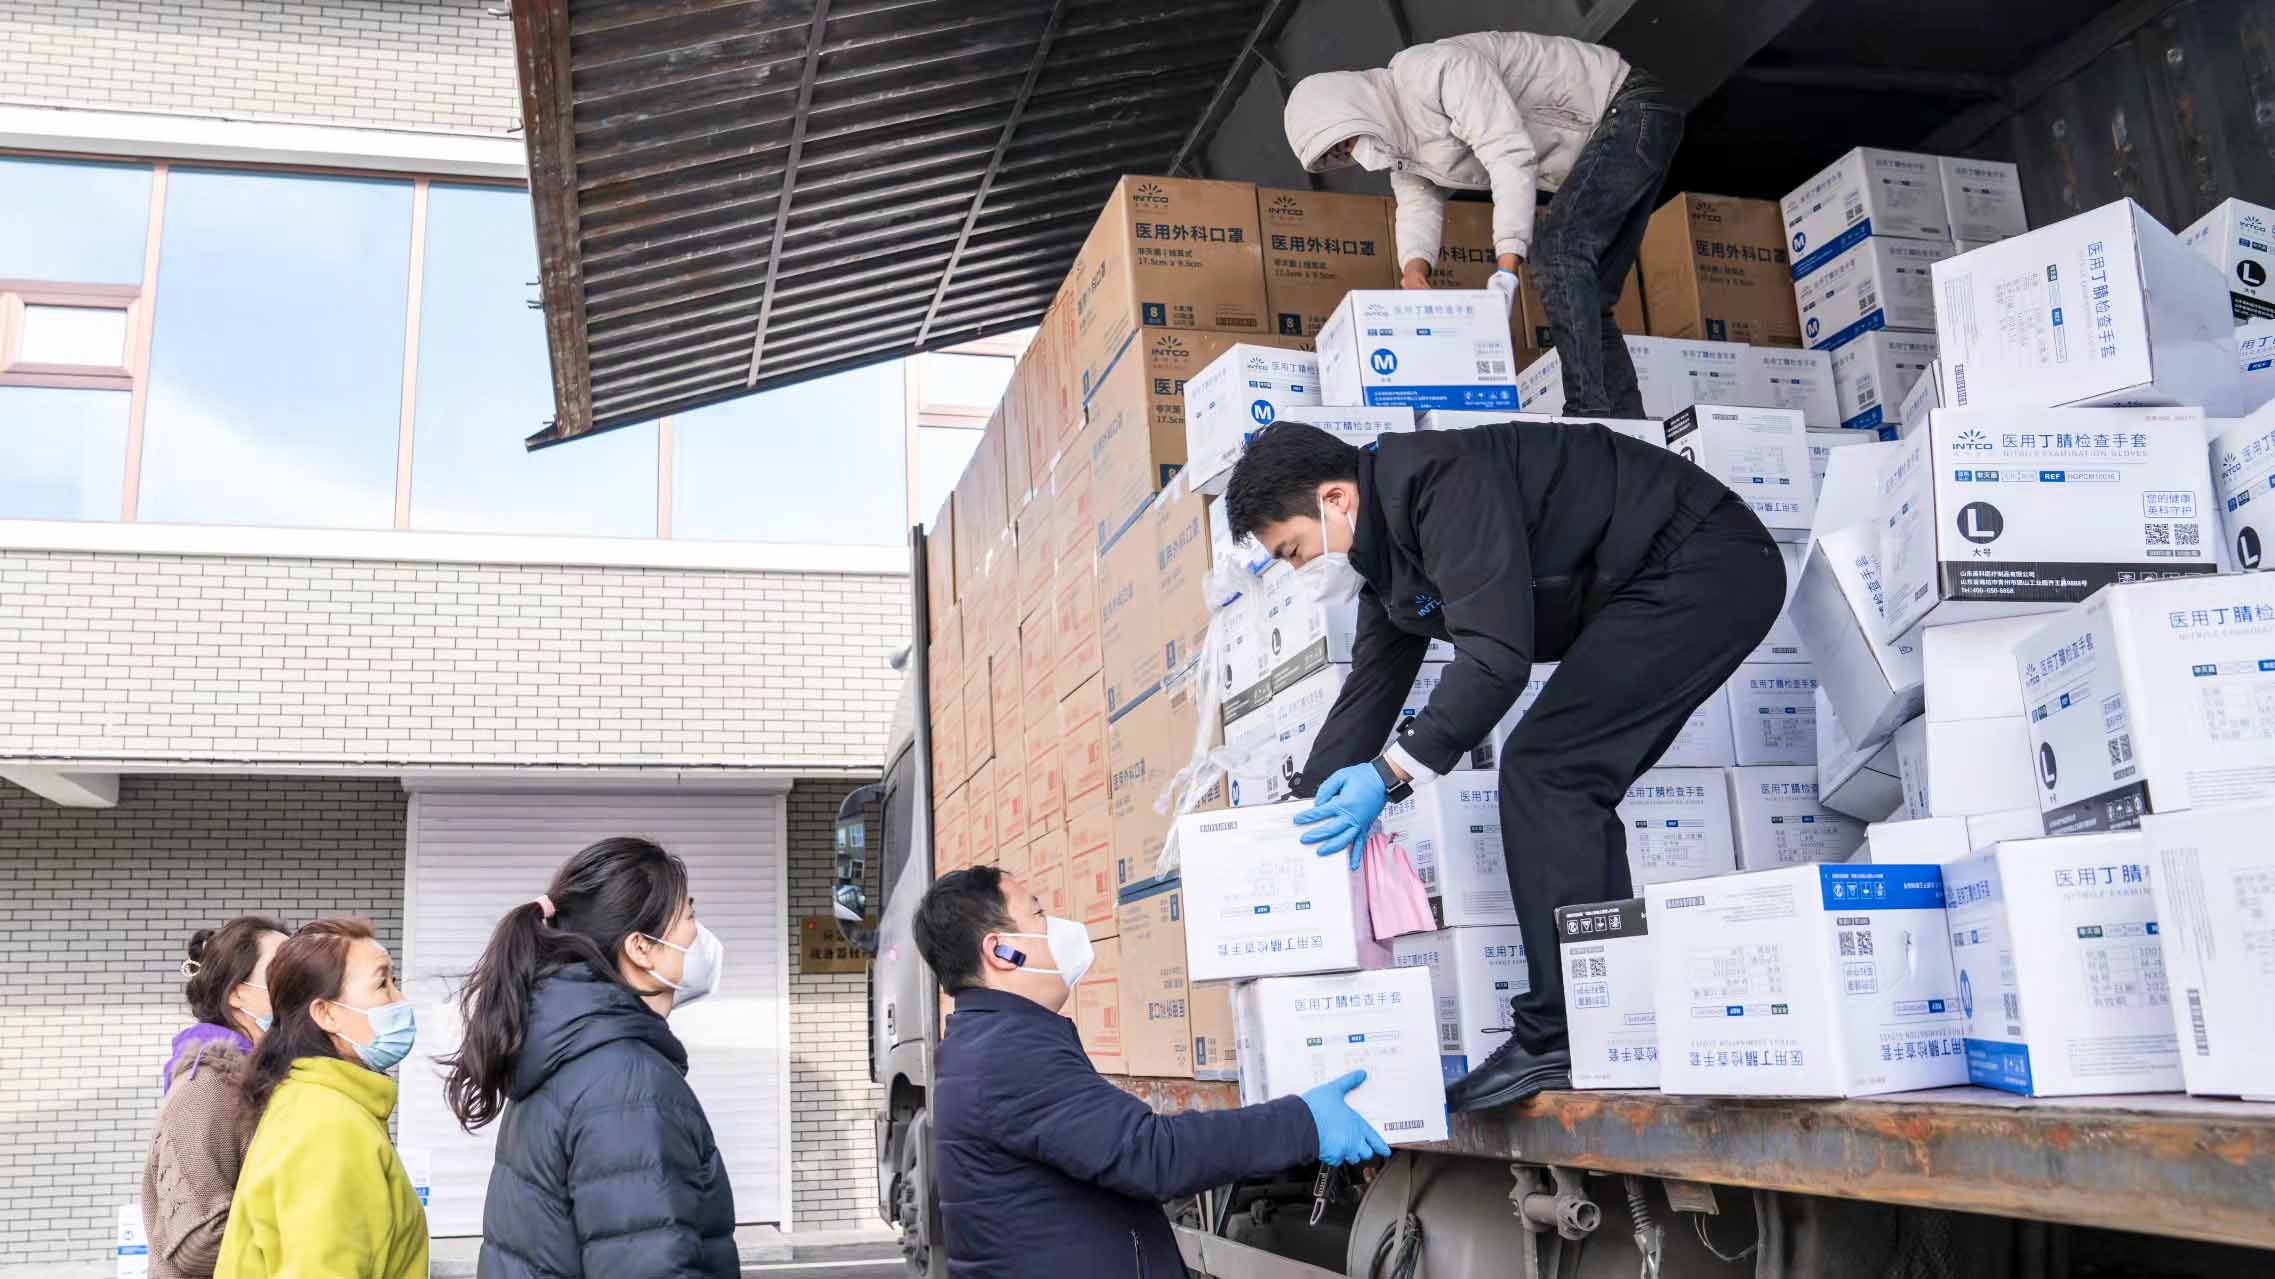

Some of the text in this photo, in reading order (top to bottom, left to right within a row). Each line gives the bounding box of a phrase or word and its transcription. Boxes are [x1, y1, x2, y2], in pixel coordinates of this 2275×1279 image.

[1133, 195, 1168, 203] INTCO
[1268, 208, 1304, 216] INTCO
[1135, 222, 1245, 243] 医用外科口罩
[1271, 235, 1376, 256] 医用外科口罩
[1794, 234, 1805, 250] M
[2243, 263, 2260, 284] L
[1806, 319, 1819, 336] M
[1152, 349, 1189, 357] INTCO
[1373, 354, 1394, 370] M
[1254, 405, 1271, 421] M
[2002, 432, 2147, 449] 医用丁腈检查手套
[2044, 472, 2062, 481] REF
[1967, 508, 1995, 537] L
[1972, 548, 1992, 558] 大号
[2240, 535, 2260, 567] L
[2168, 604, 2275, 628] 医用丁腈检
[2041, 751, 2055, 784] L
[1690, 1050, 1803, 1066] 医用丁腈检查手套
